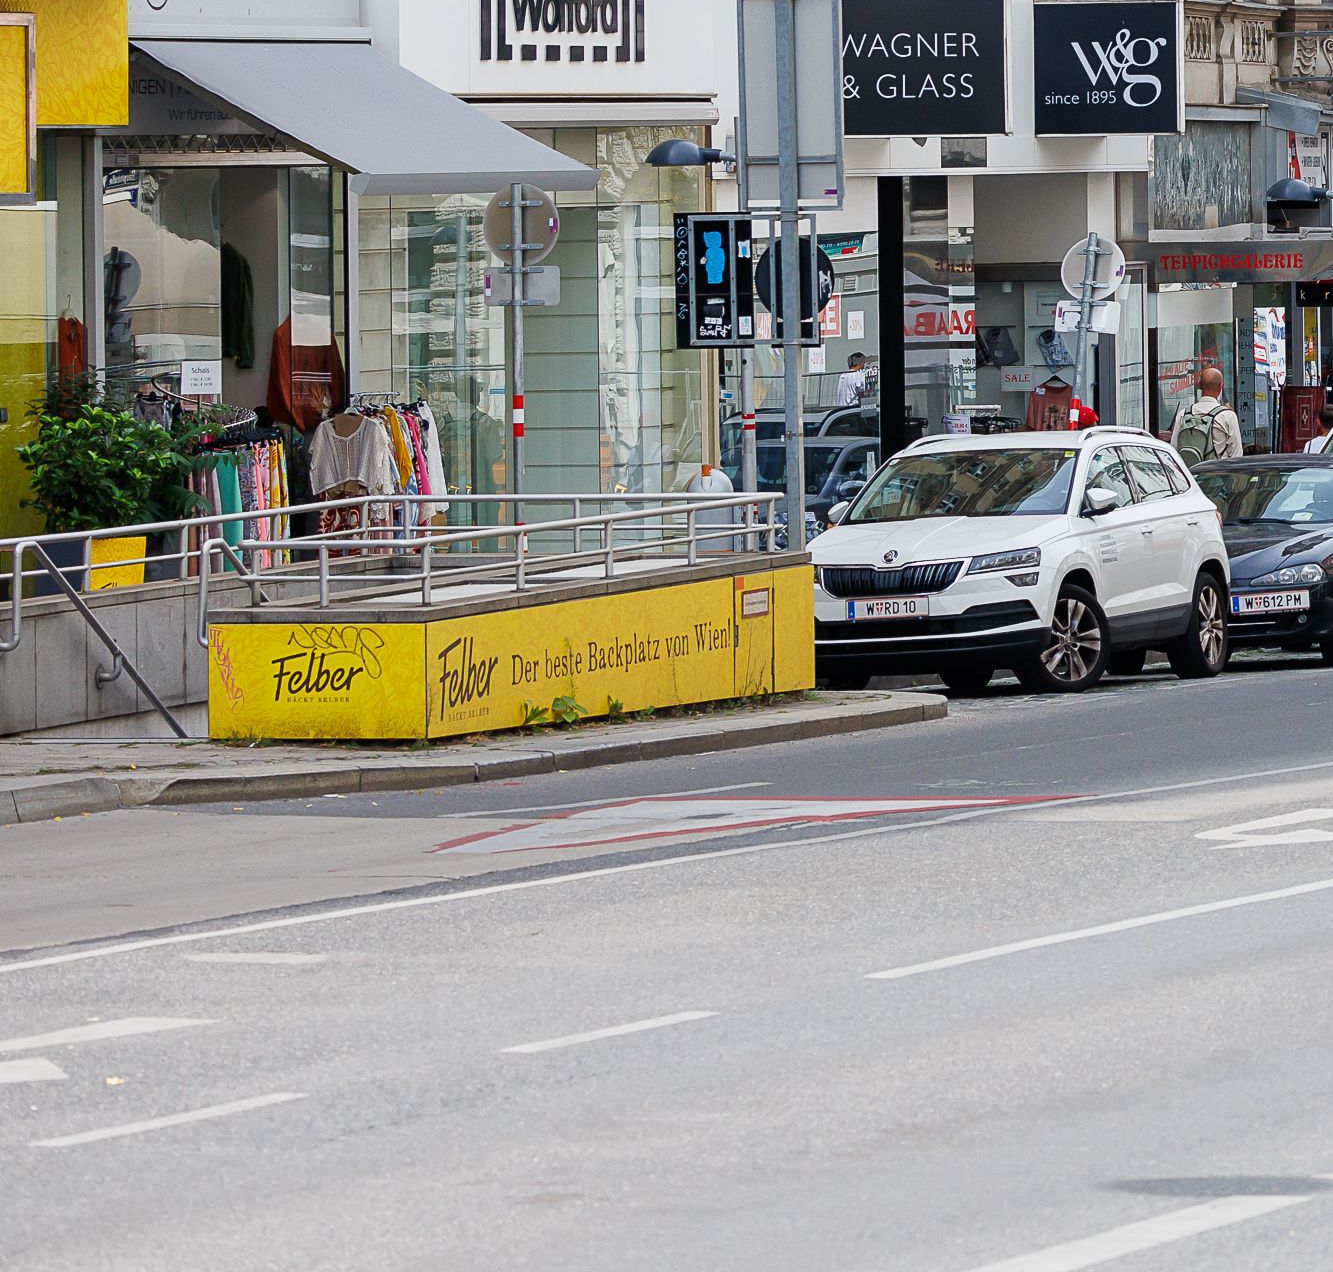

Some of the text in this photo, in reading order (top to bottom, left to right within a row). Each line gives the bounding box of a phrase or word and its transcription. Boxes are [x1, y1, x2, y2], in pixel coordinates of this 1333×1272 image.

[843, 33, 980, 59] WAGNER
[843, 73, 1117, 105] & GLASS since 1895
[1160, 253, 1304, 269] TEPPICHGALERIE
[866, 601, 916, 615] W RD 10
[1245, 594, 1302, 609] W 612 PM
[271, 651, 363, 701] Felber
[438, 618, 731, 721] Felber Der beste Backplatz von Wien!
